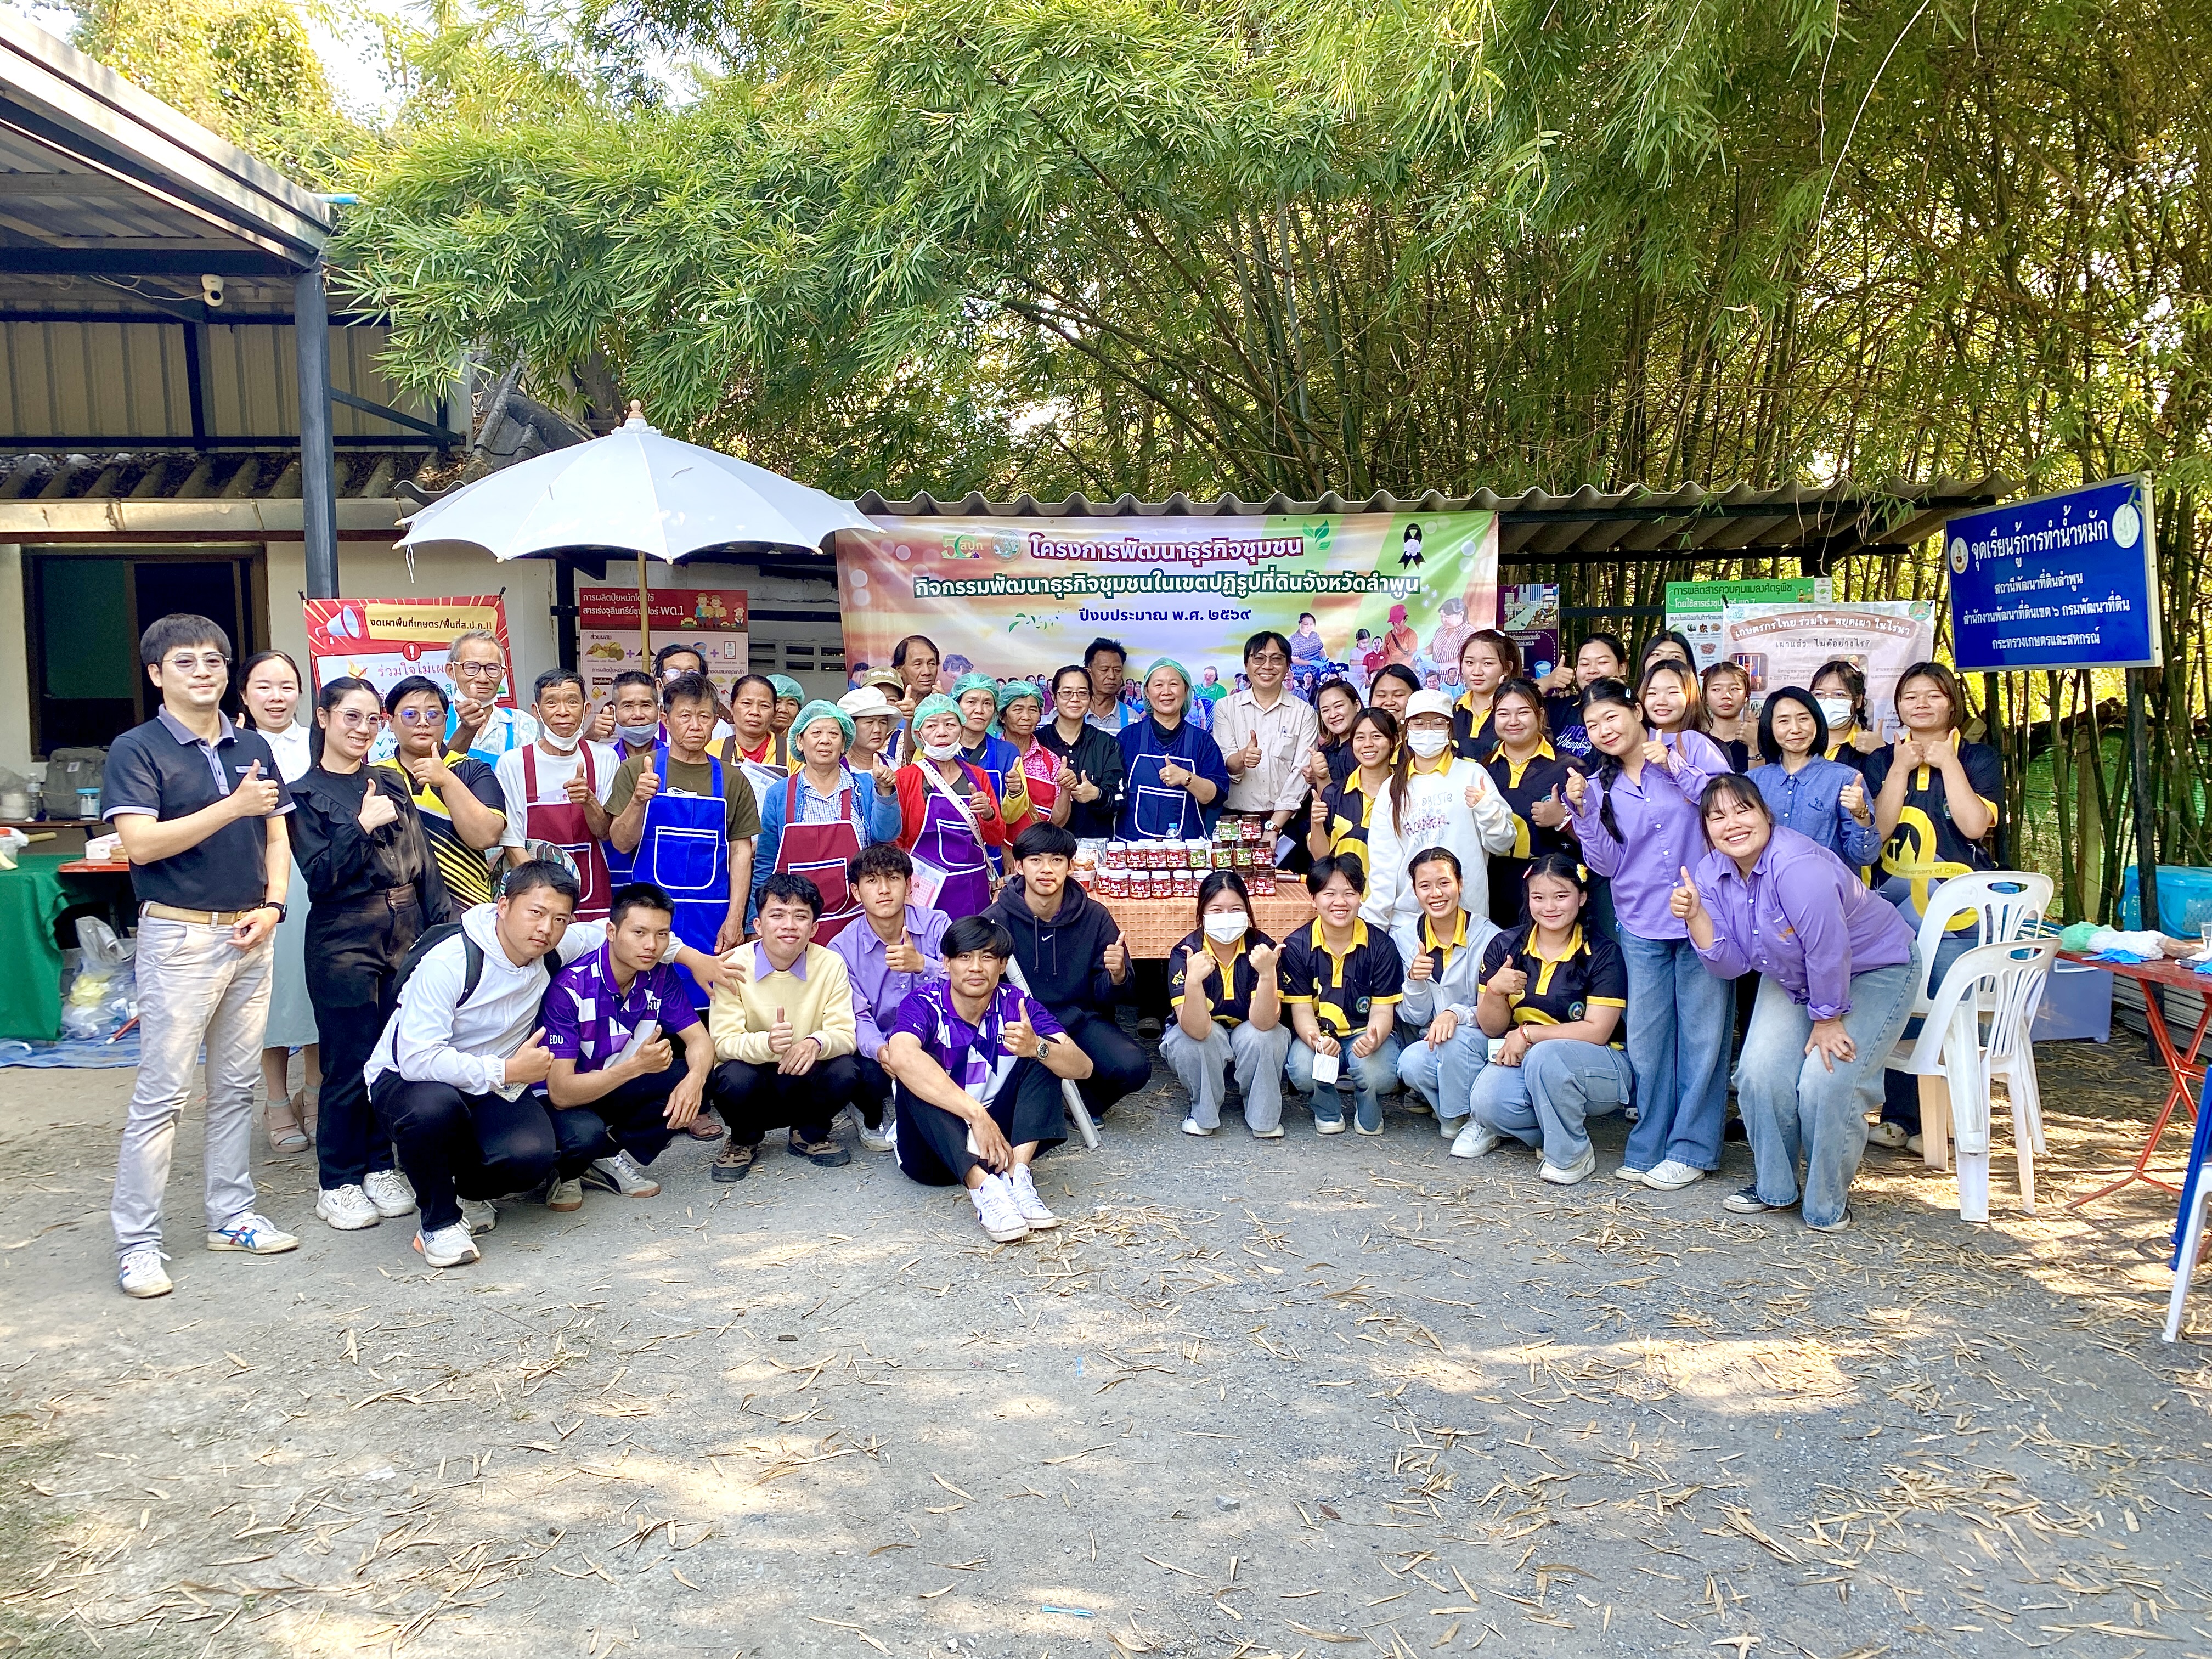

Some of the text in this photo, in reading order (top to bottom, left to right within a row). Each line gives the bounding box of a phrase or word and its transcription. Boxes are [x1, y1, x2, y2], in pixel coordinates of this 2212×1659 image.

[1030, 533, 1302, 565] โครงการพัฒนาธุรกิจชุมชน
[1972, 505, 2108, 571] จุดเรียนรู้การทำน้ำหมัก
[916, 567, 1420, 598] กิจกรรมพัฒนาธุรกิจชุมชนในเขตปฏิรูปที่ดินจังหวัดลำพูน
[1673, 583, 1792, 597] การผลิตสารควบคุมแมลงศัตรูพืช
[1994, 569, 2084, 594] สถานีพัฒนาที่ดินลำพูน
[2062, 590, 2130, 616] กรมพัฒนาที่ดิน
[370, 616, 492, 630] งดเผาพื้นที่เกษตร/พื้นที่ส.ปก.!!
[1080, 608, 1252, 622] ปีงบประมาณ พ.ศ. ๒๕๖๙
[1735, 617, 1796, 638] เกษตรกรไทย
[1799, 614, 1829, 627] ร่วมใจ
[1835, 617, 1871, 629] หยุดเผา
[1875, 618, 1911, 636] ในไร่นา
[1992, 627, 2101, 650] กระทรวงเกษตรและสหกรณ์
[378, 662, 445, 677] ร่วมใจไม่เผ
[1895, 866, 1932, 875] Anniversary
[549, 1034, 564, 1045] EDU
